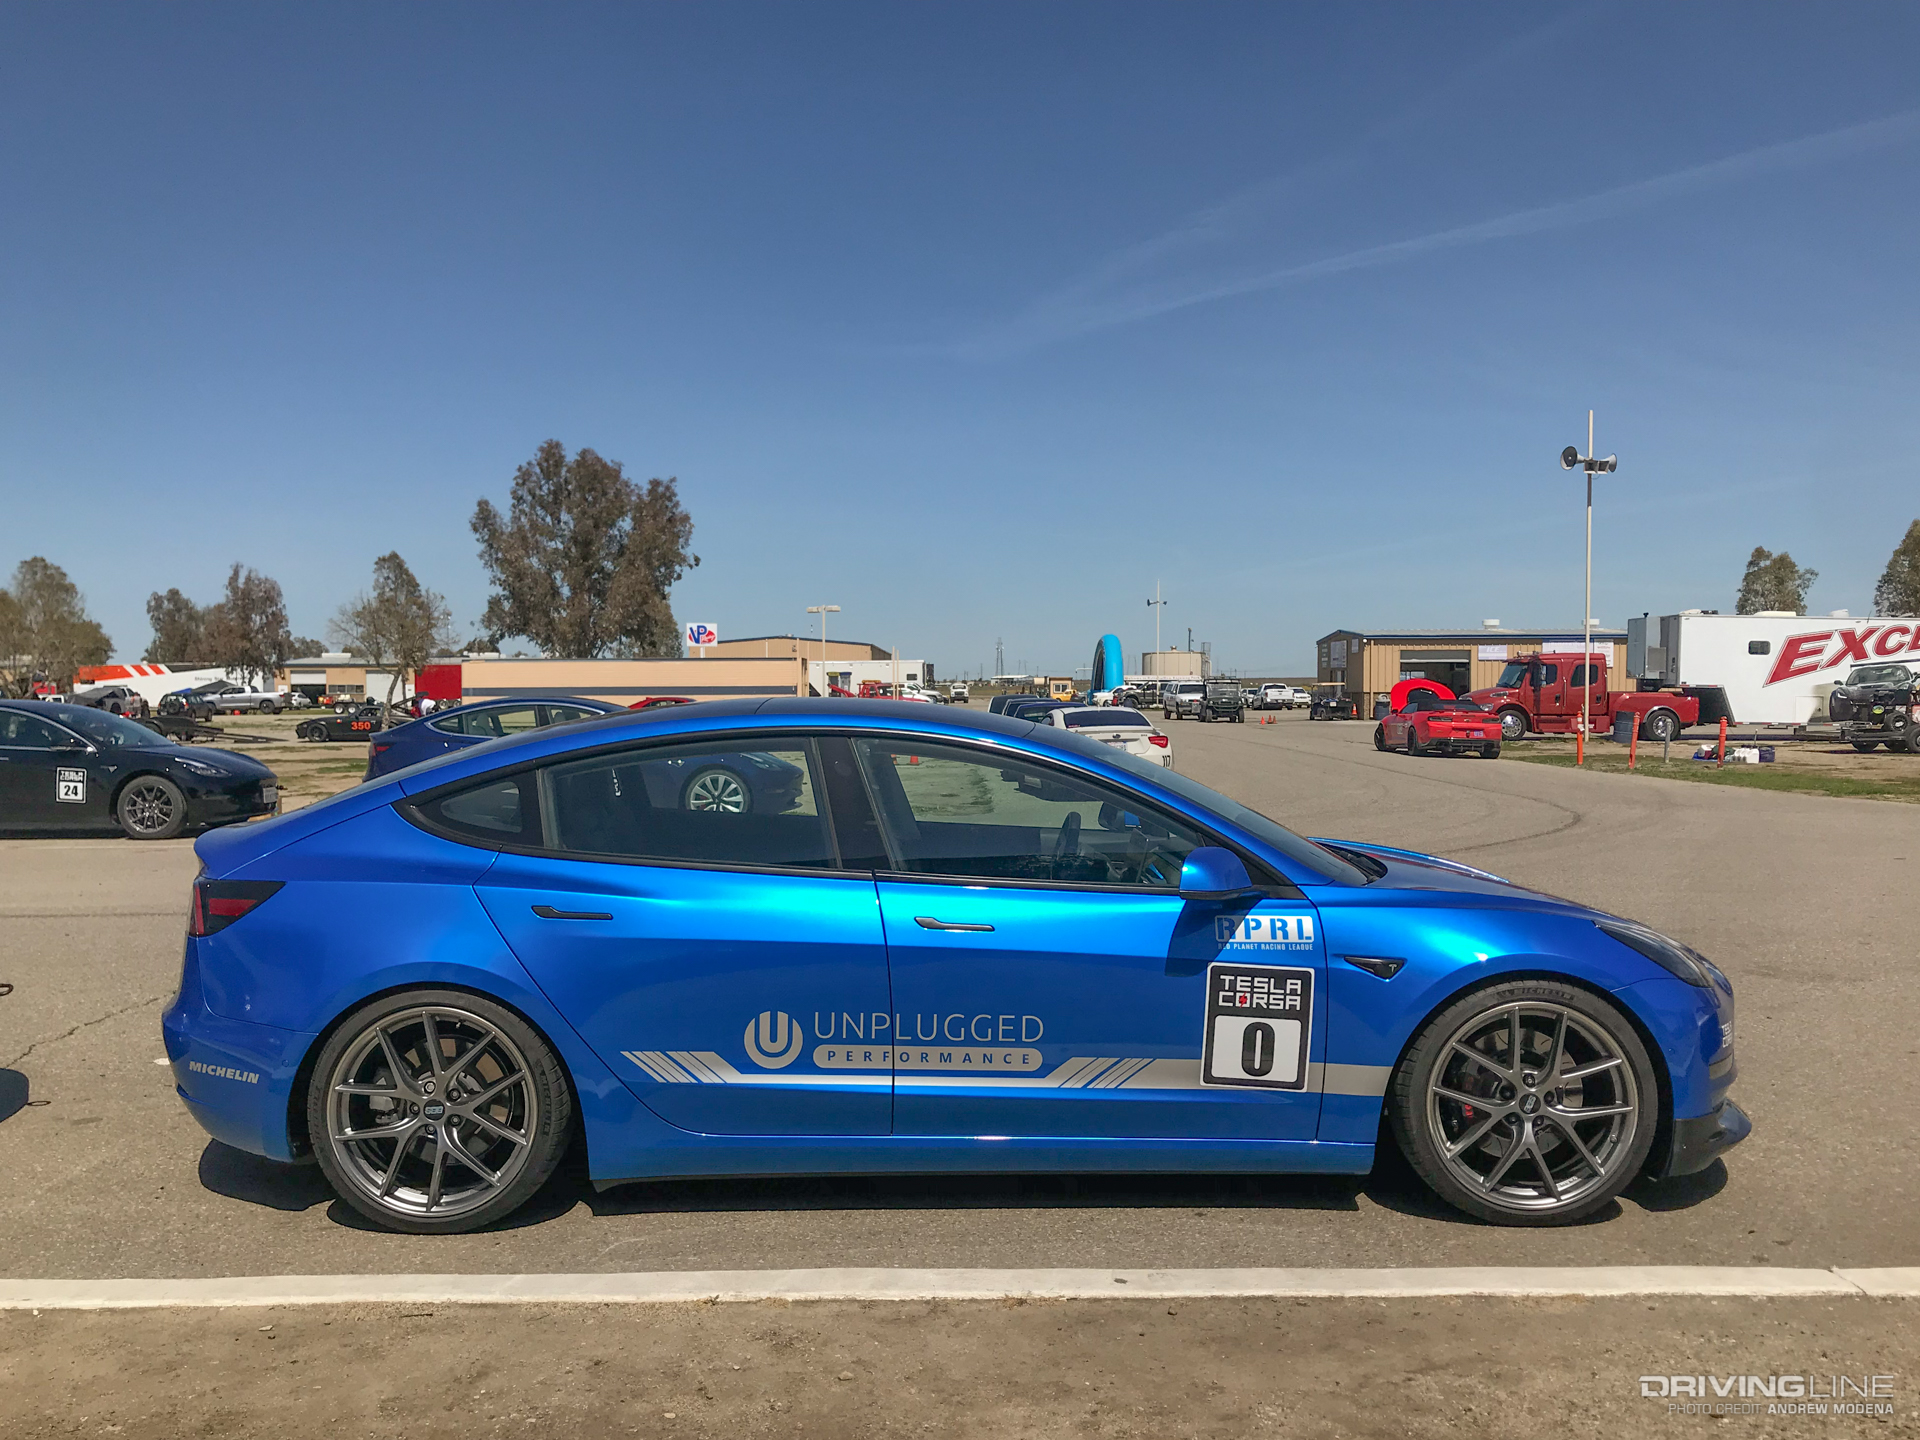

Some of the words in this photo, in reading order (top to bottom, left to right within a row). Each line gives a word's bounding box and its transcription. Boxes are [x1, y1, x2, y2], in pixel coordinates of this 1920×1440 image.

[689, 625, 707, 644] VP
[351, 721, 371, 730] 350
[64, 785, 78, 796] 24
[1219, 975, 1302, 994] TESLA
[1218, 991, 1301, 1011] CORSA
[814, 1011, 1044, 1042] UNPLUGGED
[827, 1050, 1030, 1065] PERFORMANCE
[1241, 1021, 1275, 1077] 0
[189, 1061, 260, 1084] MICHELIN
